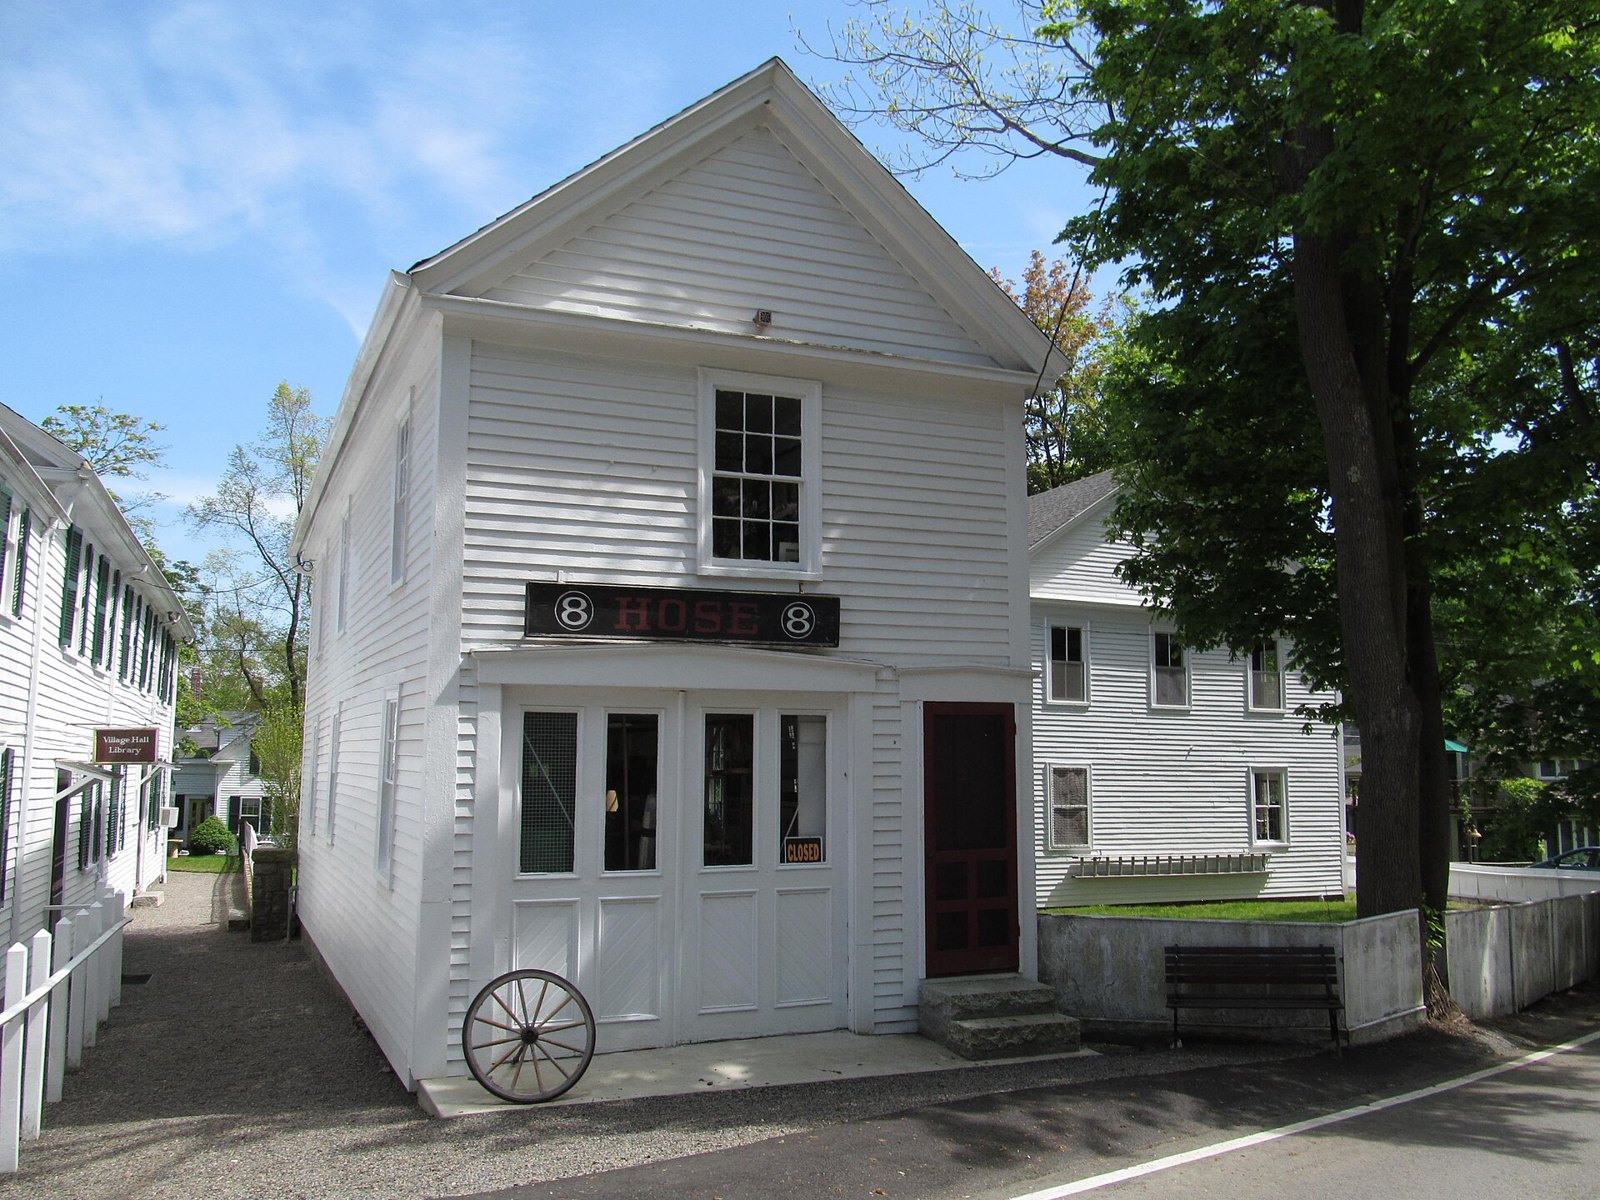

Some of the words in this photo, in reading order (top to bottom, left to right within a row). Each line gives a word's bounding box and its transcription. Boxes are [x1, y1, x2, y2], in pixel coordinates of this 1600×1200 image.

[561, 597, 587, 625] 8
[614, 597, 758, 634] HOSE
[787, 607, 810, 633] 8
[103, 736, 130, 745] Village
[109, 747, 141, 755] Library
[787, 844, 819, 862] CLOSED
